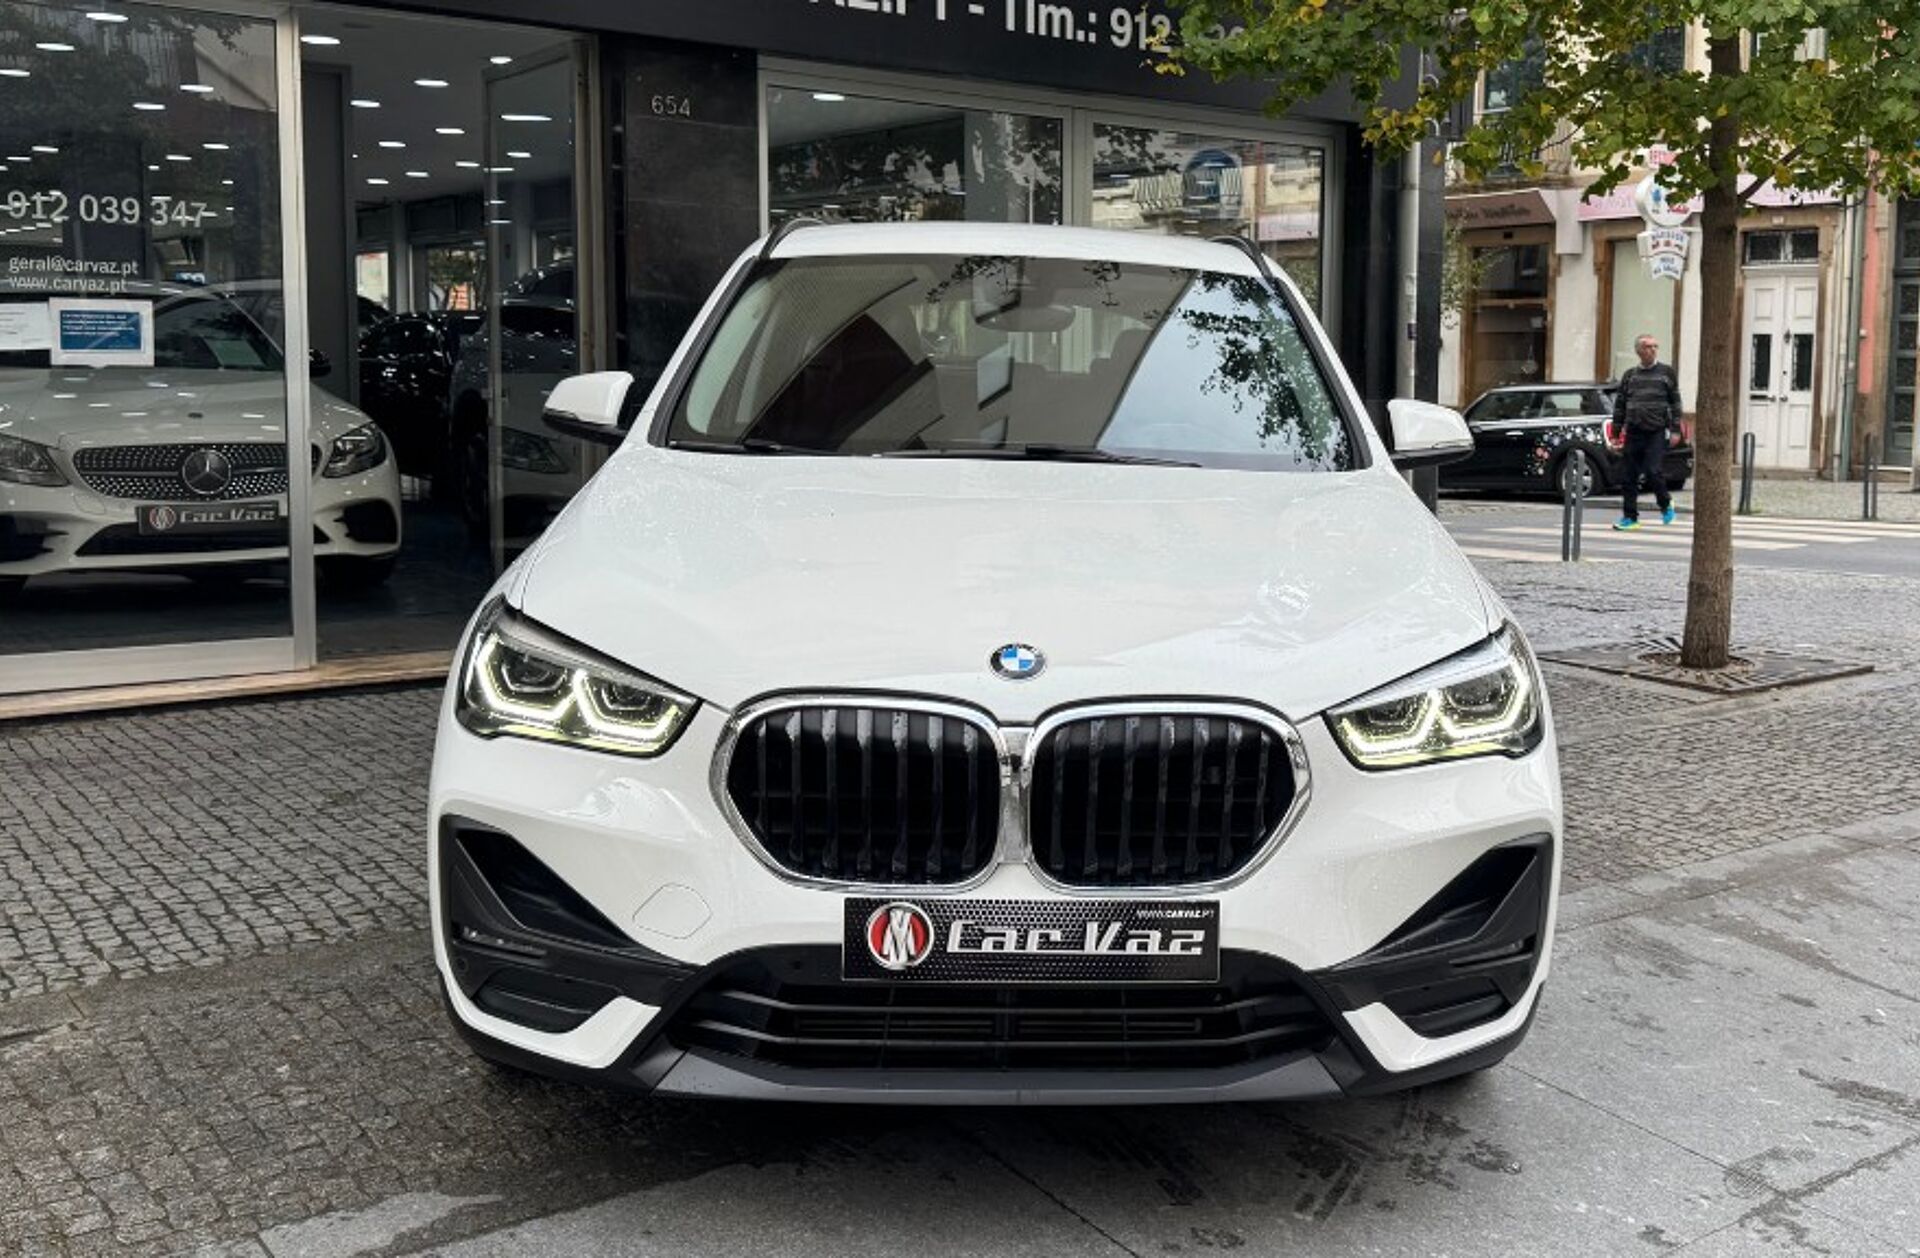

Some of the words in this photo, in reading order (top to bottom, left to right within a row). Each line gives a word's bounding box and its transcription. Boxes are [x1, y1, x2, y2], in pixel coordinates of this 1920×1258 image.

[651, 95, 690, 117] 654
[7, 190, 69, 222] 912
[79, 194, 140, 224] 039
[150, 199, 208, 228] 347
[8, 255, 139, 276] geral@carvaz.pt
[9, 276, 128, 294] www.carvaz.pt
[947, 919, 1062, 953] Car
[1083, 920, 1206, 955] Vaz
